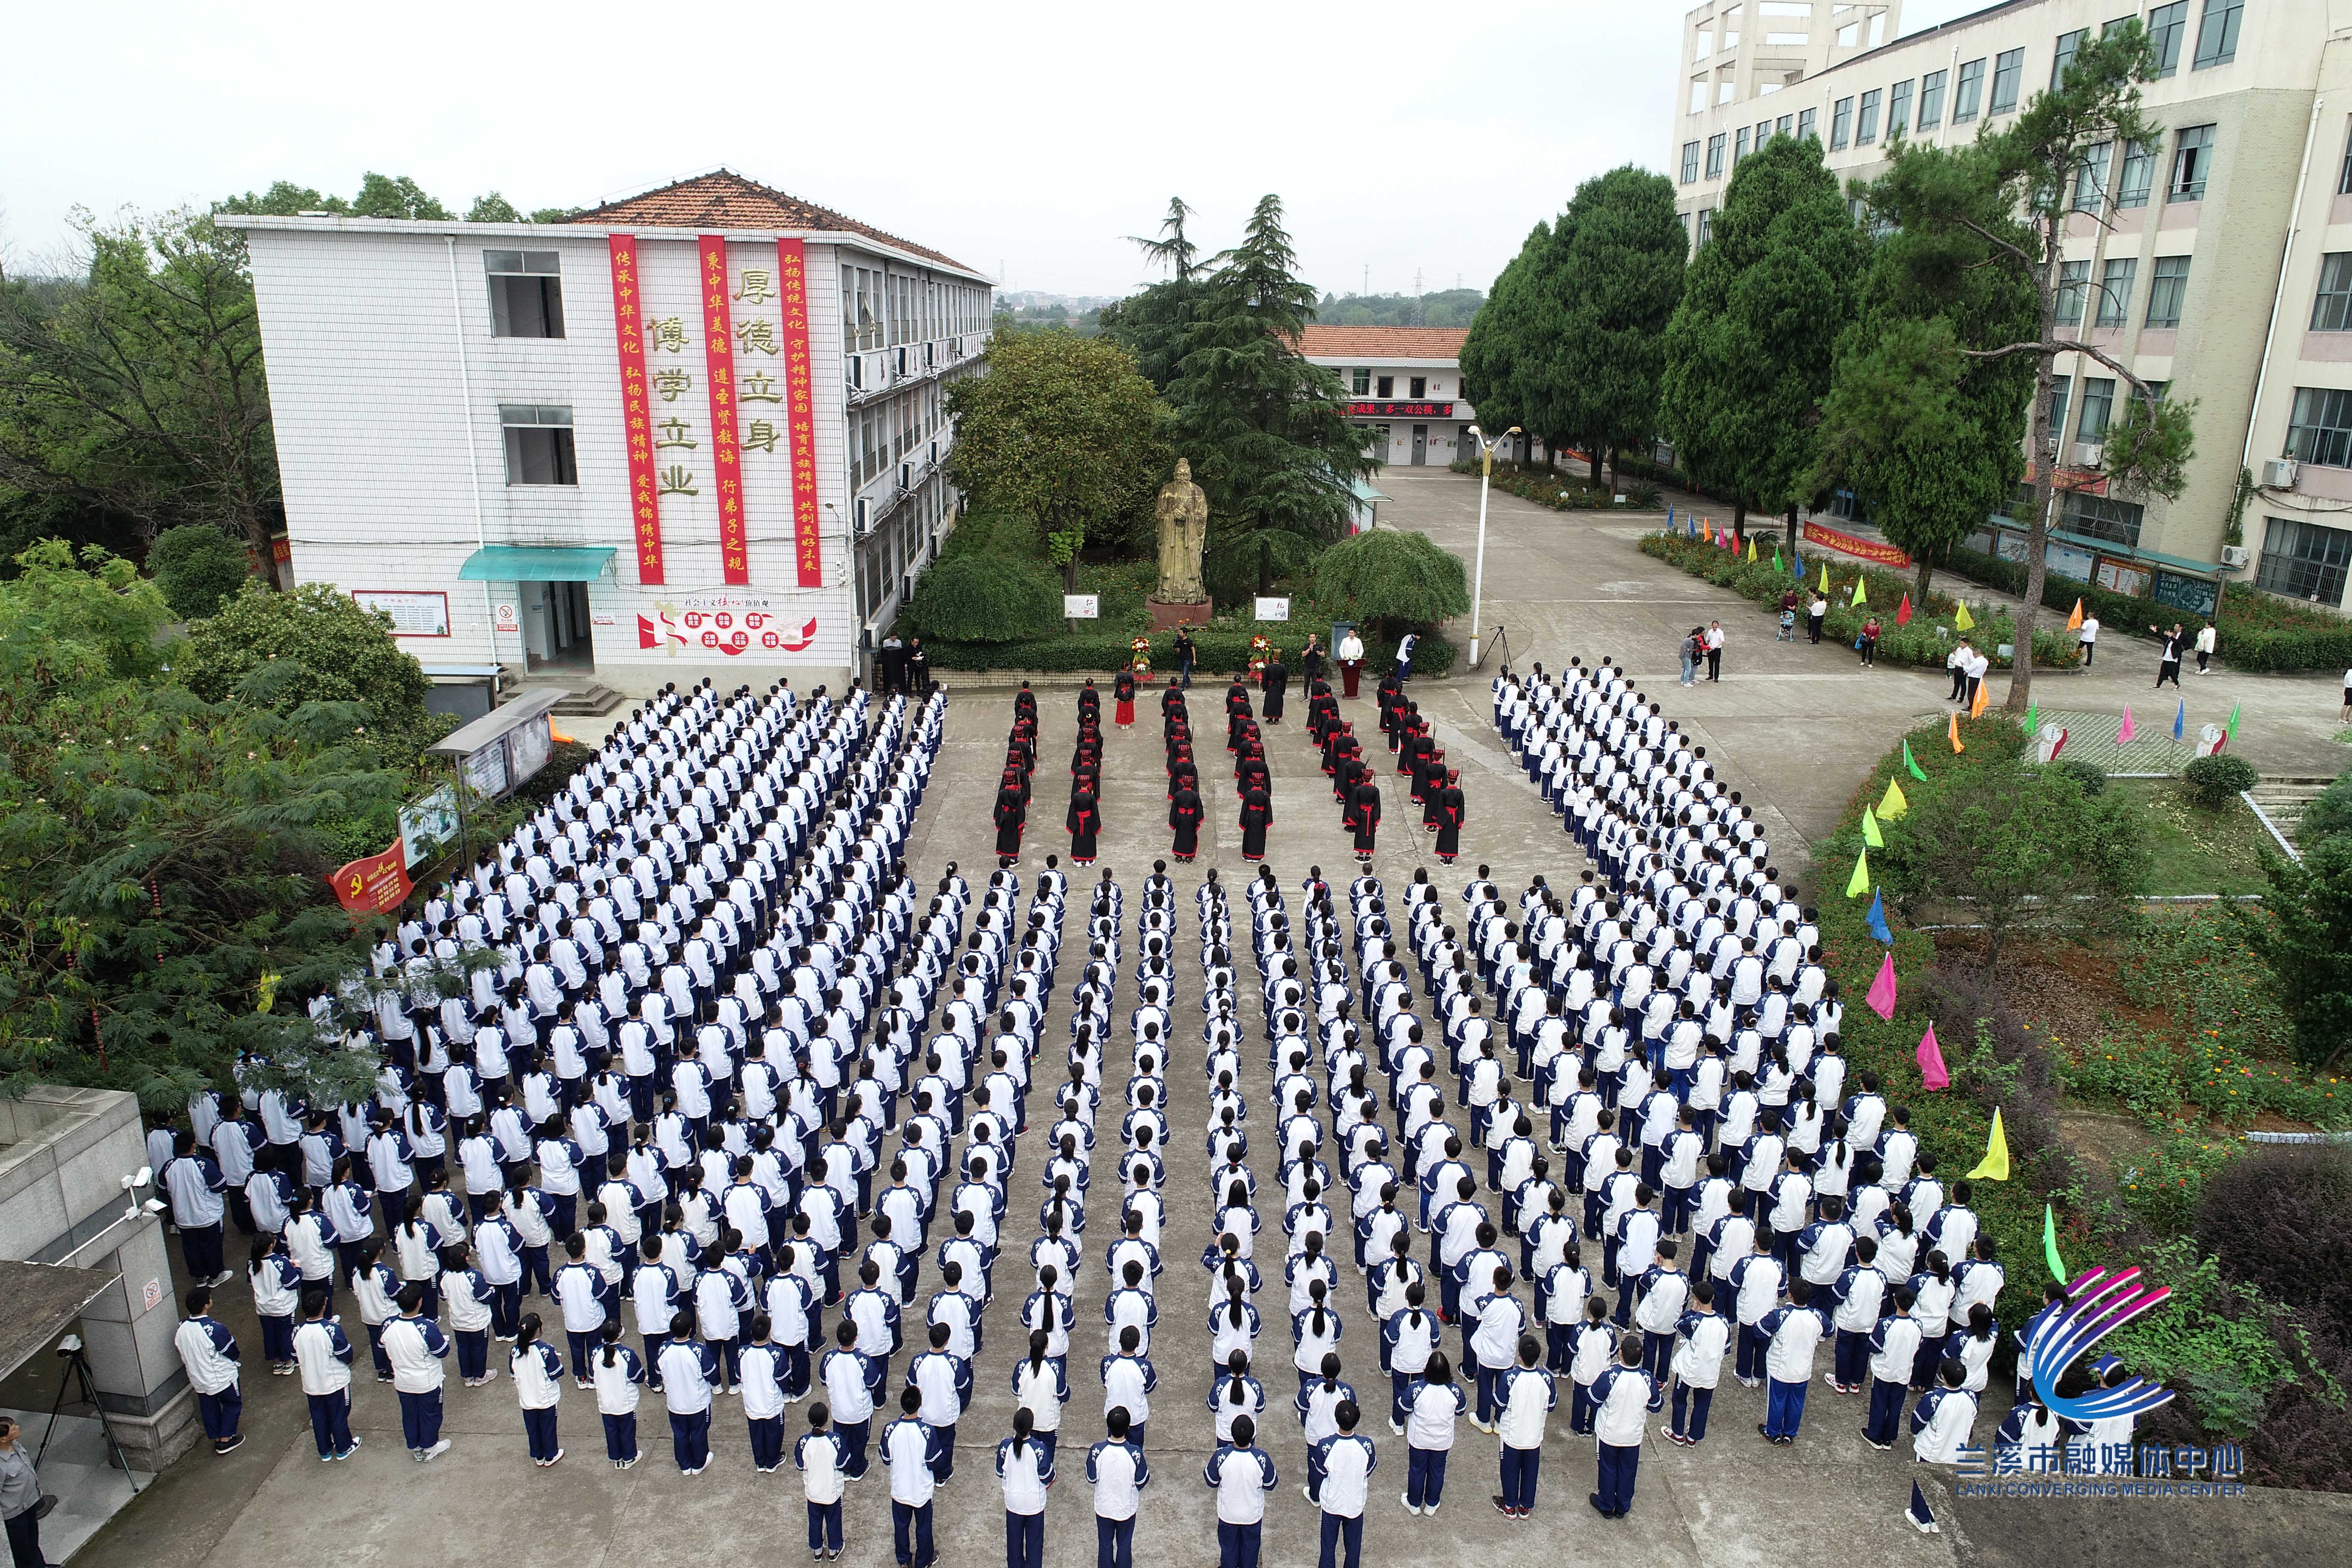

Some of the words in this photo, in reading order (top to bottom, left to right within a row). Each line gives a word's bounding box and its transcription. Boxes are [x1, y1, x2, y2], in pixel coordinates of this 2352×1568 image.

[616, 251, 640, 353] 传承中华文化
[706, 251, 727, 354] 秉中华美德
[785, 254, 805, 329] 弘扬传统文化
[647, 316, 699, 496] 博学立业
[733, 268, 783, 453] 厚德立身
[790, 339, 808, 413] 守护精神家园
[626, 367, 649, 465] 弘扬民族精神
[714, 367, 735, 465] 遵圣贤教诲
[794, 421, 813, 493] 培育民族精神
[637, 474, 658, 569] 爱我锦绣中华
[722, 479, 744, 571] 行弟子之规
[798, 501, 818, 571] 共创美好未来
[686, 596, 769, 607] 社会主义核心价值观
